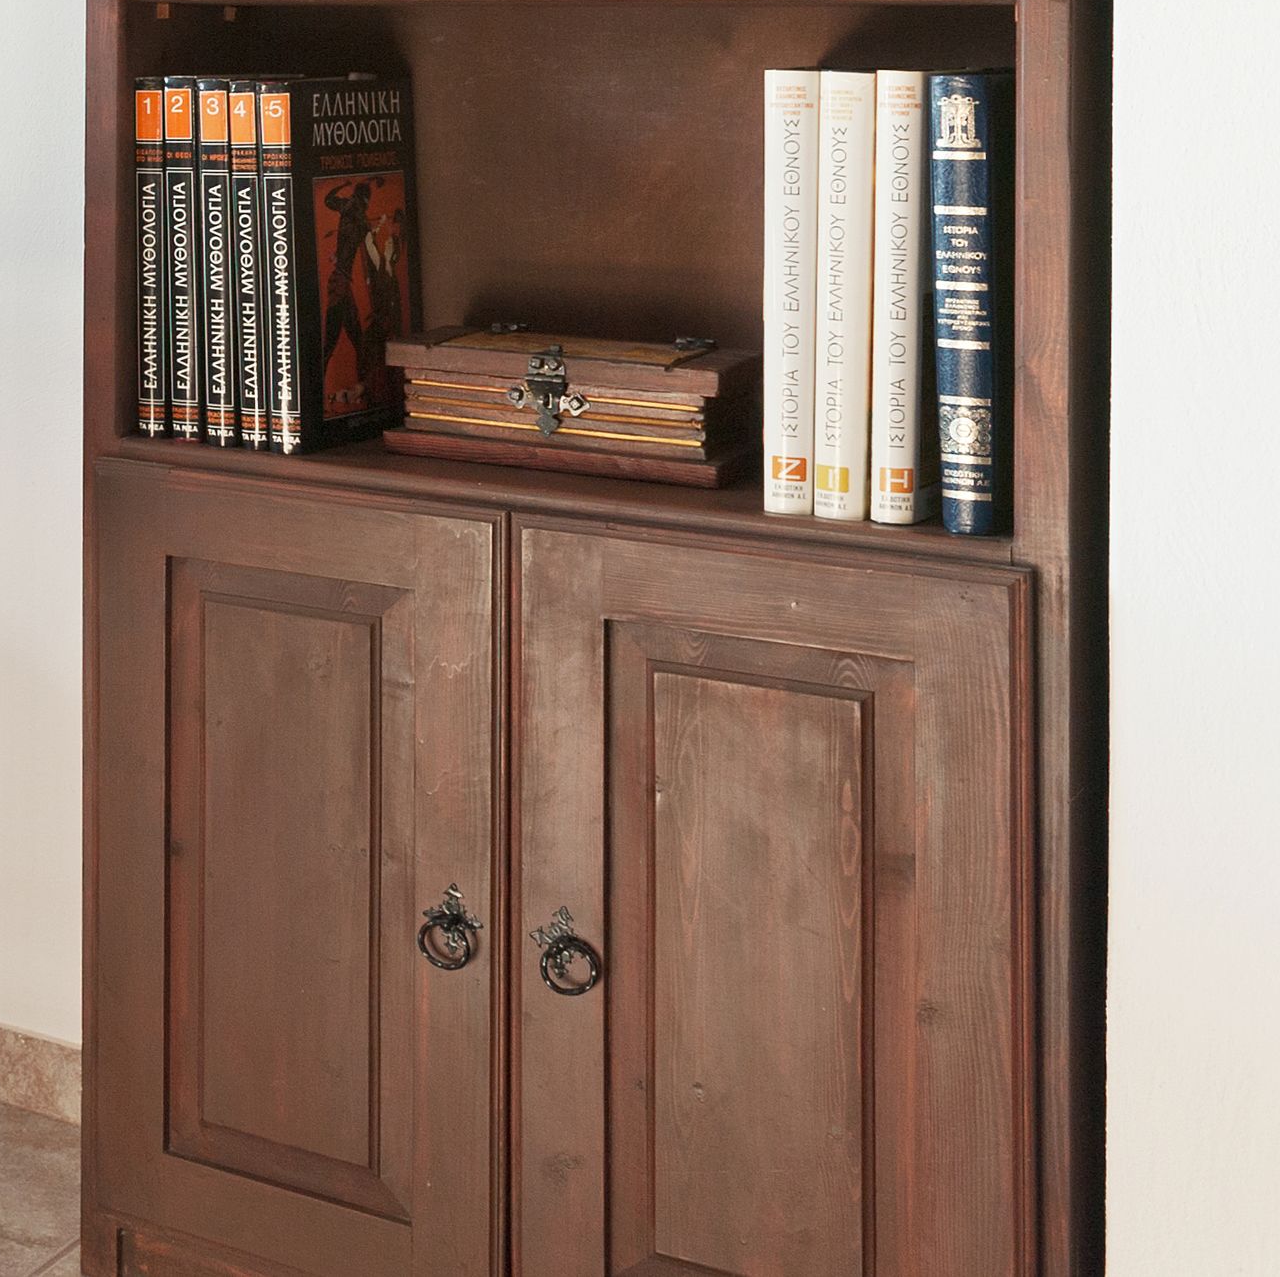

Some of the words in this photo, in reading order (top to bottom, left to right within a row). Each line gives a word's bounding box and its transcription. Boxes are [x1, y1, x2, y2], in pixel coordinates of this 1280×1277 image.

[142, 98, 152, 115] 1
[170, 95, 184, 113] 2
[205, 97, 219, 116] 3
[232, 99, 246, 117] 4
[267, 99, 282, 118] 5
[311, 118, 402, 147] ΜΥΘΟΛΟΓΙΑ
[312, 91, 400, 118] ΕΛΛΗΝΙΚΗ
[783, 119, 802, 196] ΕΘΝΟΥΣ
[830, 127, 848, 205] ΕΘΝΟΥΣ
[891, 124, 911, 204] ΕΘΝΟΥΣ
[141, 182, 156, 288] ΜΥΘΟΛΟΓΙΑ
[172, 182, 188, 288] ΜΥΘΟΛΟΓΙΑ
[208, 184, 223, 291] ΜΥΘΟΛΟΓΙΑ
[238, 187, 254, 295] ΜΥΘΟΛΟΓΙΑ
[271, 187, 288, 296] ΜΥΘΟΛΟΓΙΑ
[783, 205, 801, 312] ΕΛΛΗΝΙΚΟΥ
[827, 214, 846, 322] ΕΛΛΗΝΙΚΟΥ
[890, 212, 908, 322] ΕΛΛΗΝΙΚΟΥ
[143, 295, 158, 389] ΕΛΛΗΝΙΚΗ
[175, 295, 190, 389] ΕΛΛΗΝΙΚΗ
[210, 298, 225, 394] ΕΛΛΗΝΙΚΗ
[241, 302, 257, 398] ΕΛΛΗΝΙΚΗ
[782, 322, 800, 358] ΤΟΥ
[826, 332, 844, 367] ΤΟΥ
[889, 331, 907, 365] ΤΟΥ
[781, 370, 799, 438] ΙΣΤΟΡΙΑ
[824, 379, 843, 448] ΙΣΤΟΡΙΑ
[887, 378, 906, 449] ΙΣΤΟΡΙΑ
